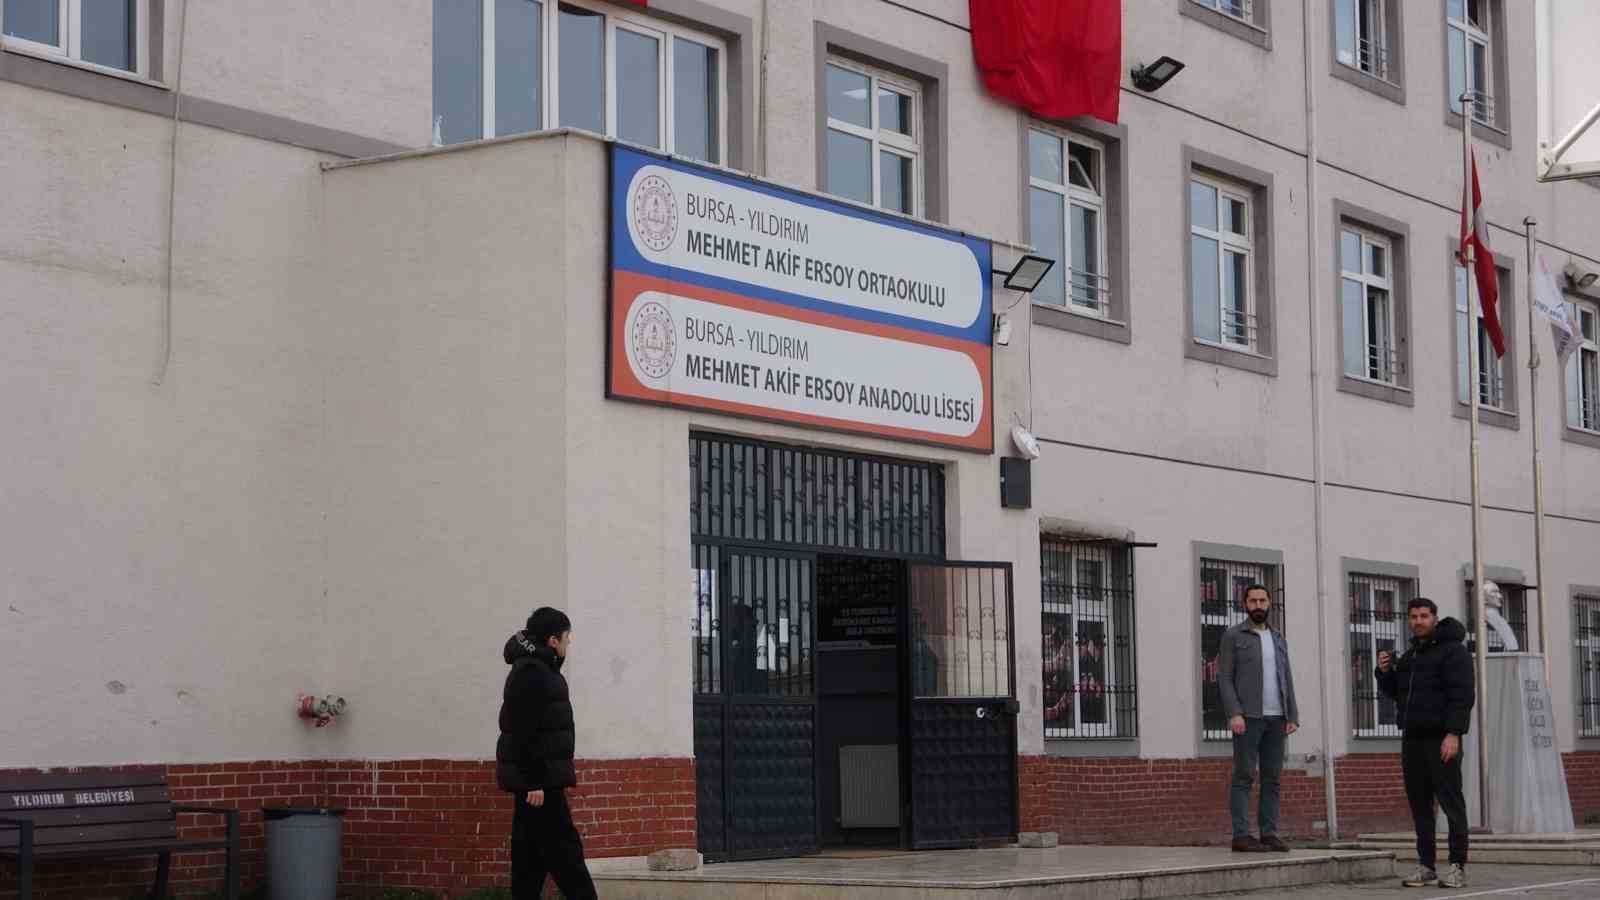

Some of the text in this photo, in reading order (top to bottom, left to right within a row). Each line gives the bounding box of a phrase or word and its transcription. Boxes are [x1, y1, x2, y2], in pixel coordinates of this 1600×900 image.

[687, 192, 737, 226] BURSA
[747, 208, 808, 244] YILDIRIM
[687, 229, 945, 308] MEHMET AKİF ERSOY ORTAOKULU
[686, 317, 735, 347] BURSA
[747, 329, 808, 362] YILDIRIM
[686, 353, 974, 423] MEHMET AKİF ERSOY ANADOLU LİSESİ
[12, 788, 135, 807] YILDIRIM BELEDİYESİ
